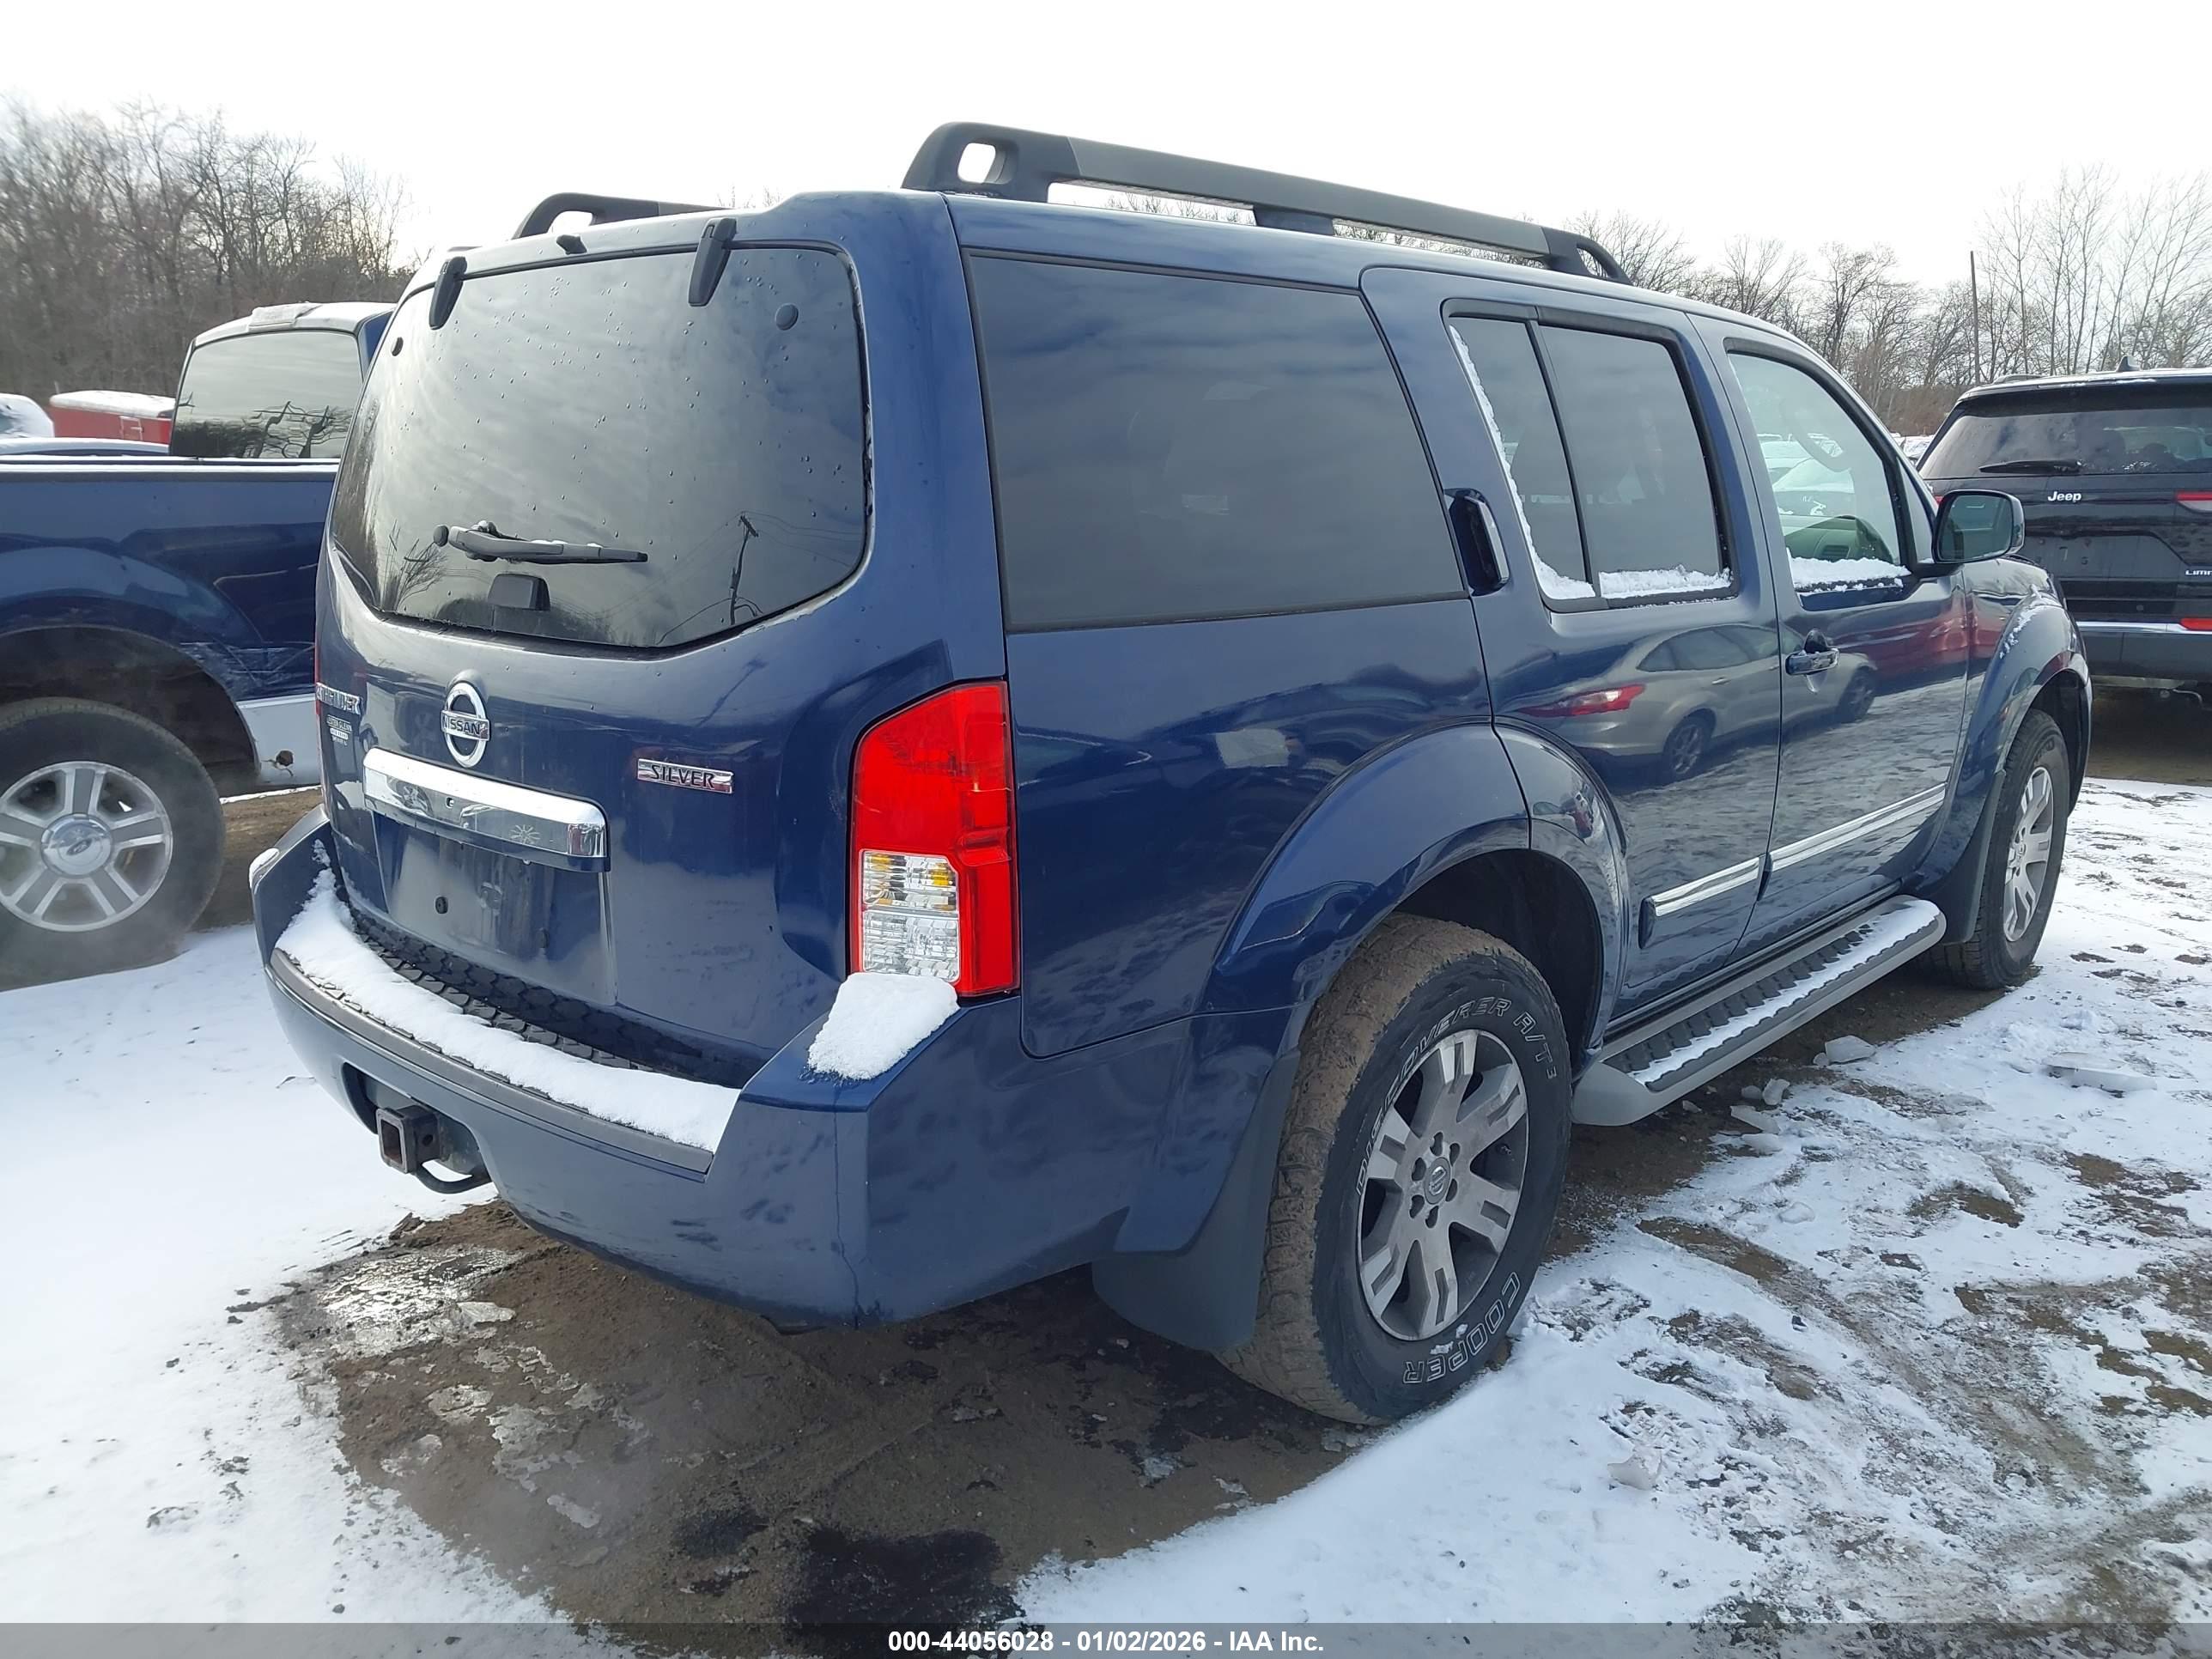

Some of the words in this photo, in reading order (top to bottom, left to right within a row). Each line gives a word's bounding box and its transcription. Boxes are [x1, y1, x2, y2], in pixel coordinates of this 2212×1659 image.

[2047, 490, 2082, 503] Jeep
[441, 712, 481, 736] NISSAN
[650, 763, 715, 788] SILVER
[1403, 1271, 1521, 1384] COOPER
